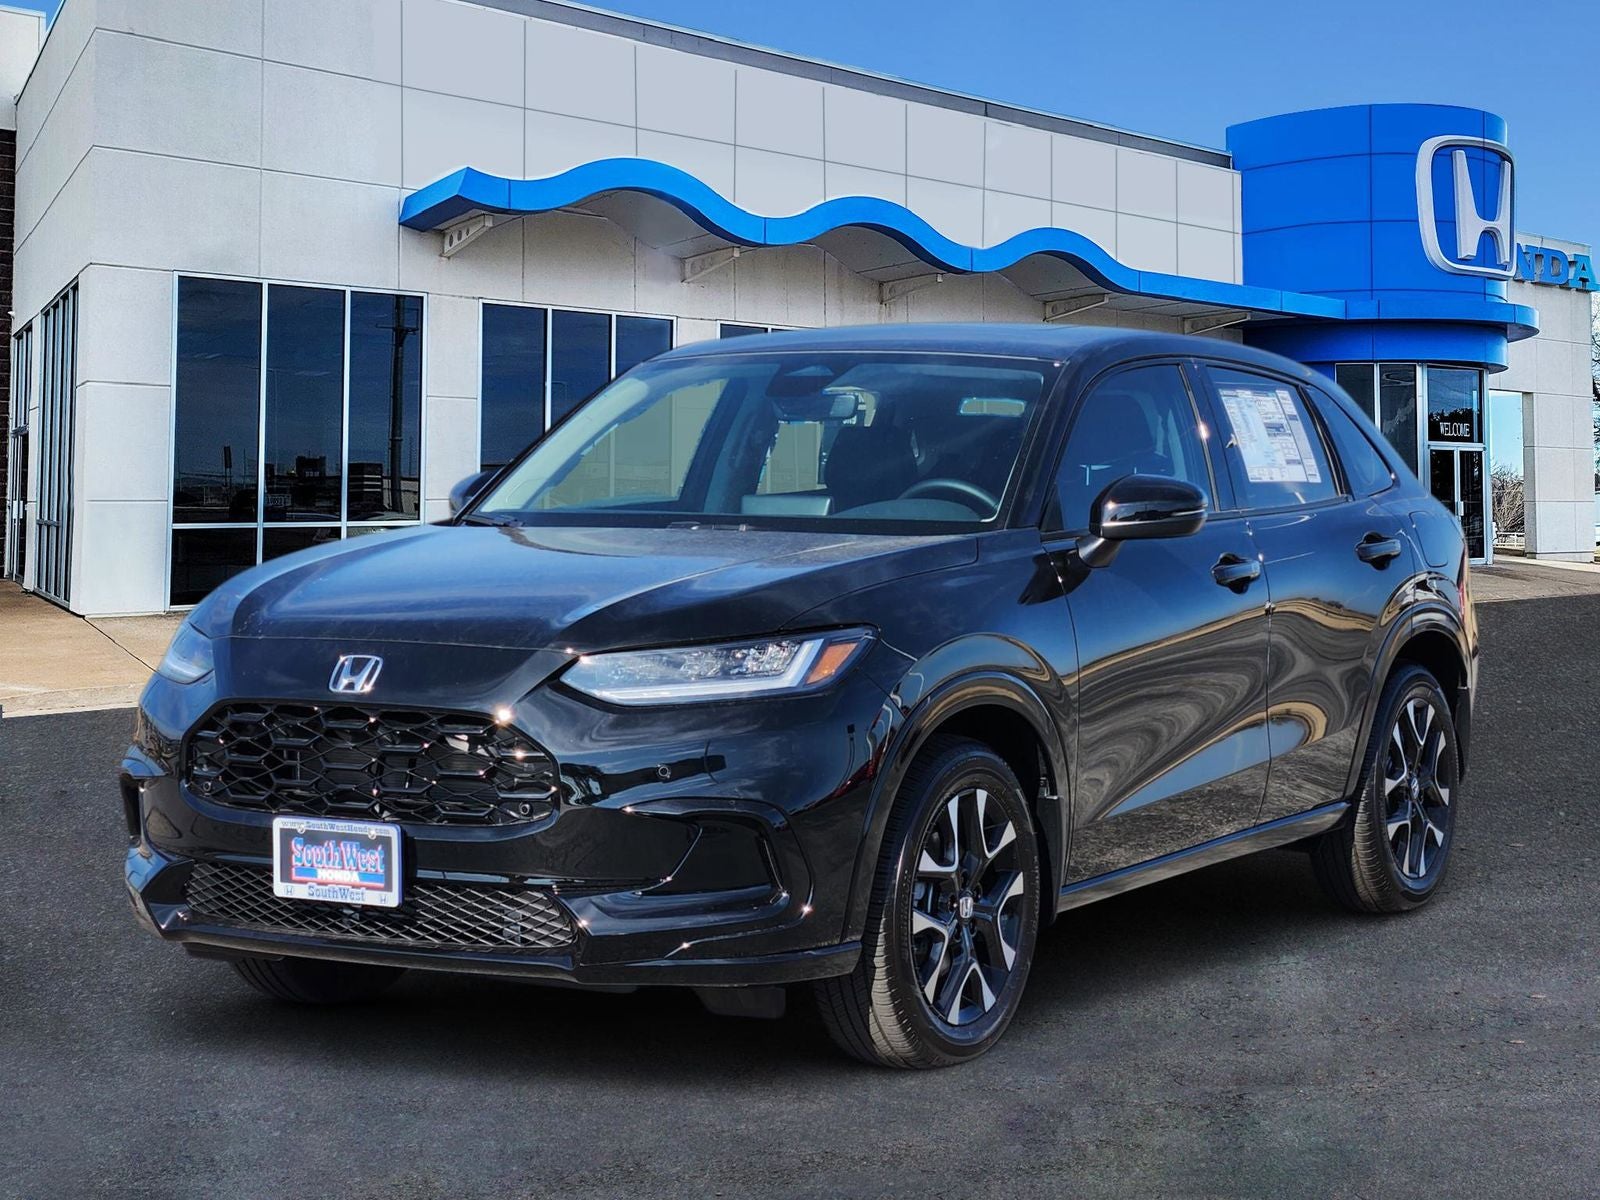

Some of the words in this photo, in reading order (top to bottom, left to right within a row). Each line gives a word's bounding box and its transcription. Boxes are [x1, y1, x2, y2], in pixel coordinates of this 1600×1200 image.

[1440, 422, 1470, 437] WELCOME
[292, 837, 385, 872] SouthWest
[308, 886, 366, 901] SouthWest
